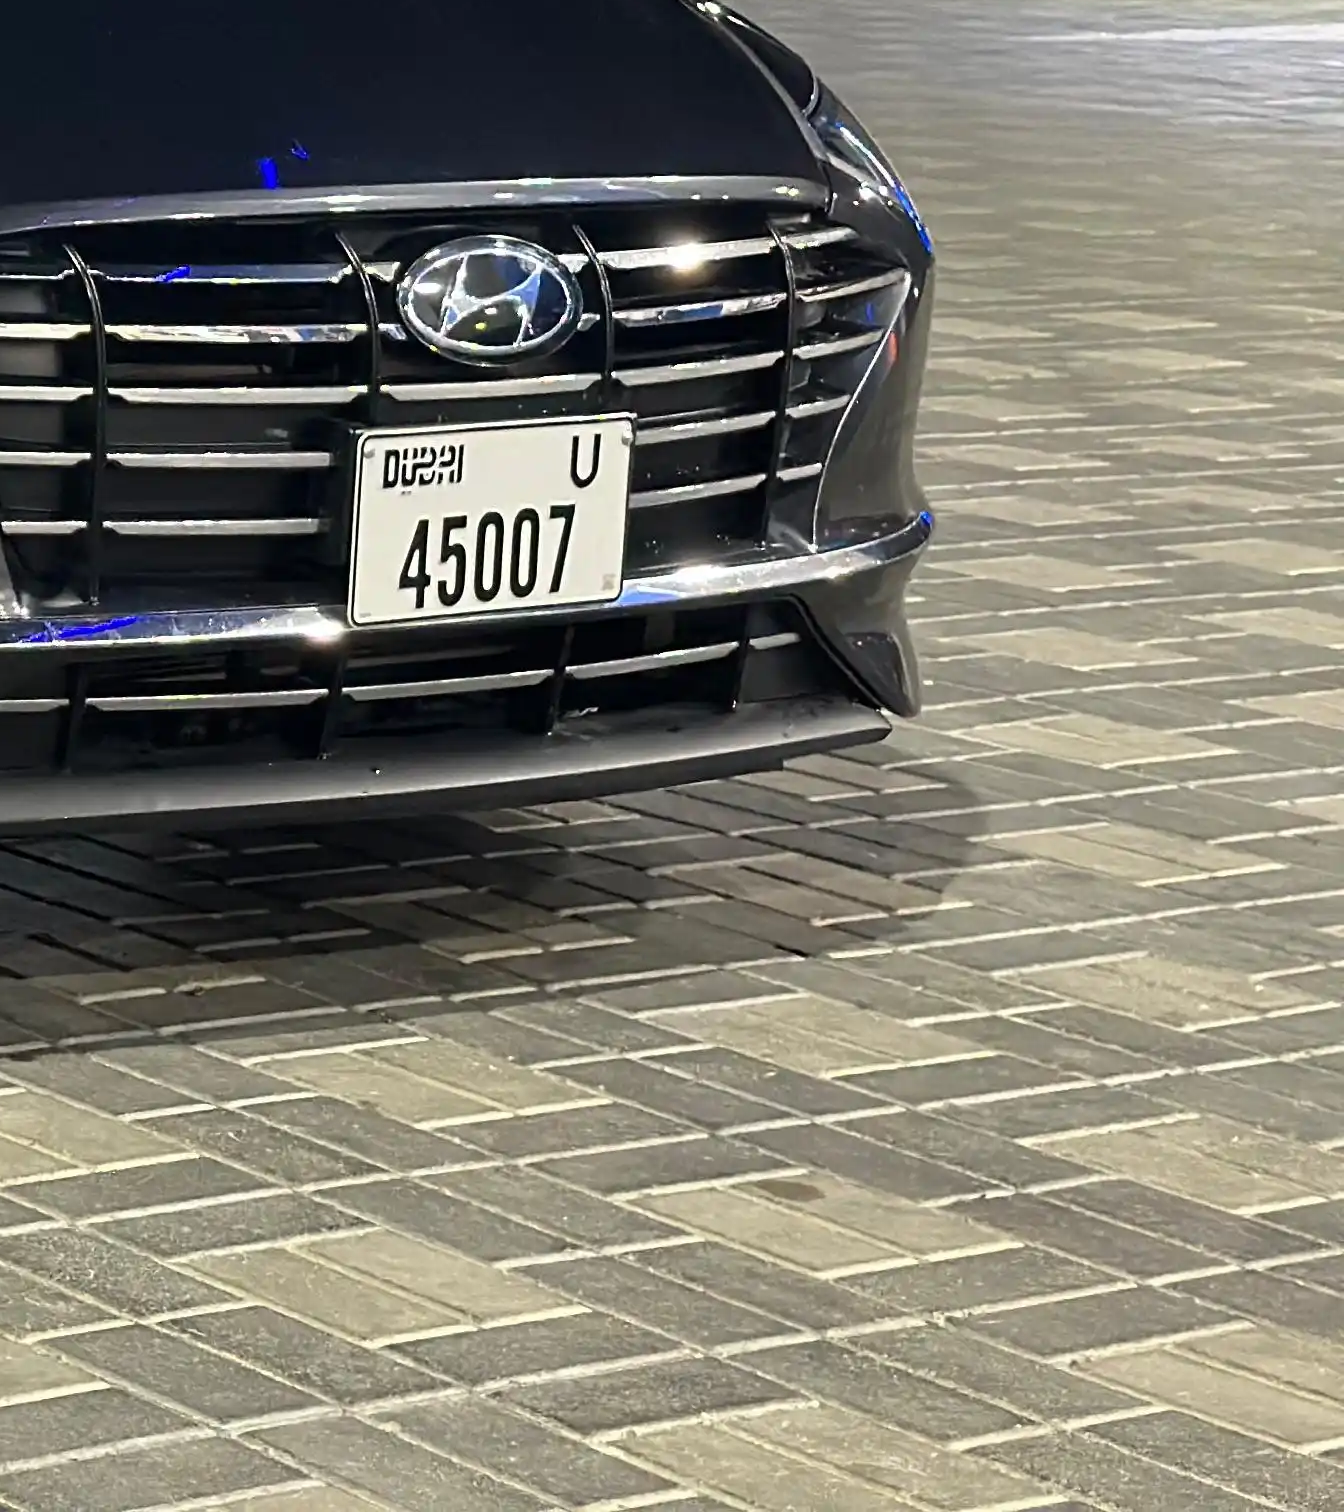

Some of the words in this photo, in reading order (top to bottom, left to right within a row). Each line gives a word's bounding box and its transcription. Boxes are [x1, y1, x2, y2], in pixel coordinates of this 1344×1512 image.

[382, 443, 465, 490] DUBAI
[570, 433, 602, 489] U
[399, 503, 576, 609] 45007
